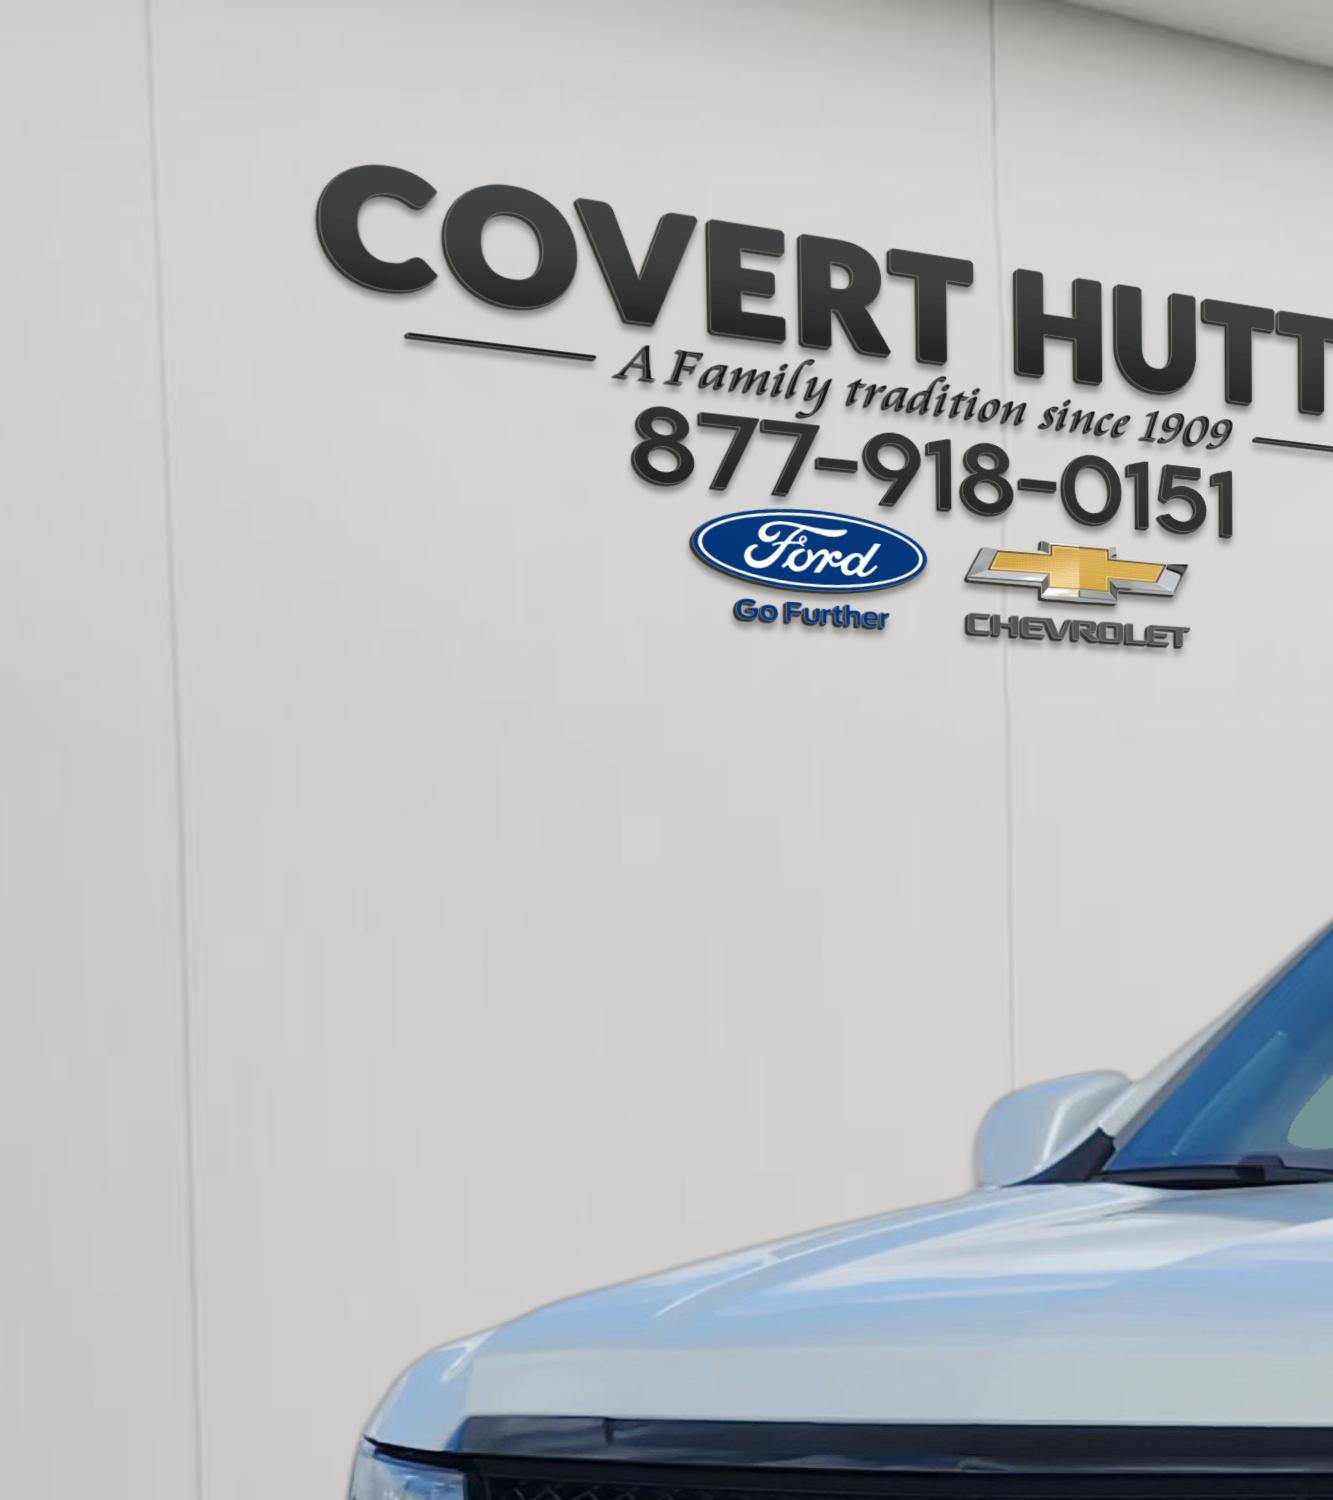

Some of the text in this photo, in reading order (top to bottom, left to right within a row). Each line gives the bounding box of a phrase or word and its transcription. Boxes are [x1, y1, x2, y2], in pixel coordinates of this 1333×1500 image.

[314, 163, 975, 368] COVERT
[612, 344, 1234, 451] A Family tradition since 1909
[629, 405, 1234, 541] 877-918-0151
[742, 519, 882, 579] Ford
[732, 597, 891, 632] Go Further
[963, 612, 1191, 651] CHEVROLET
